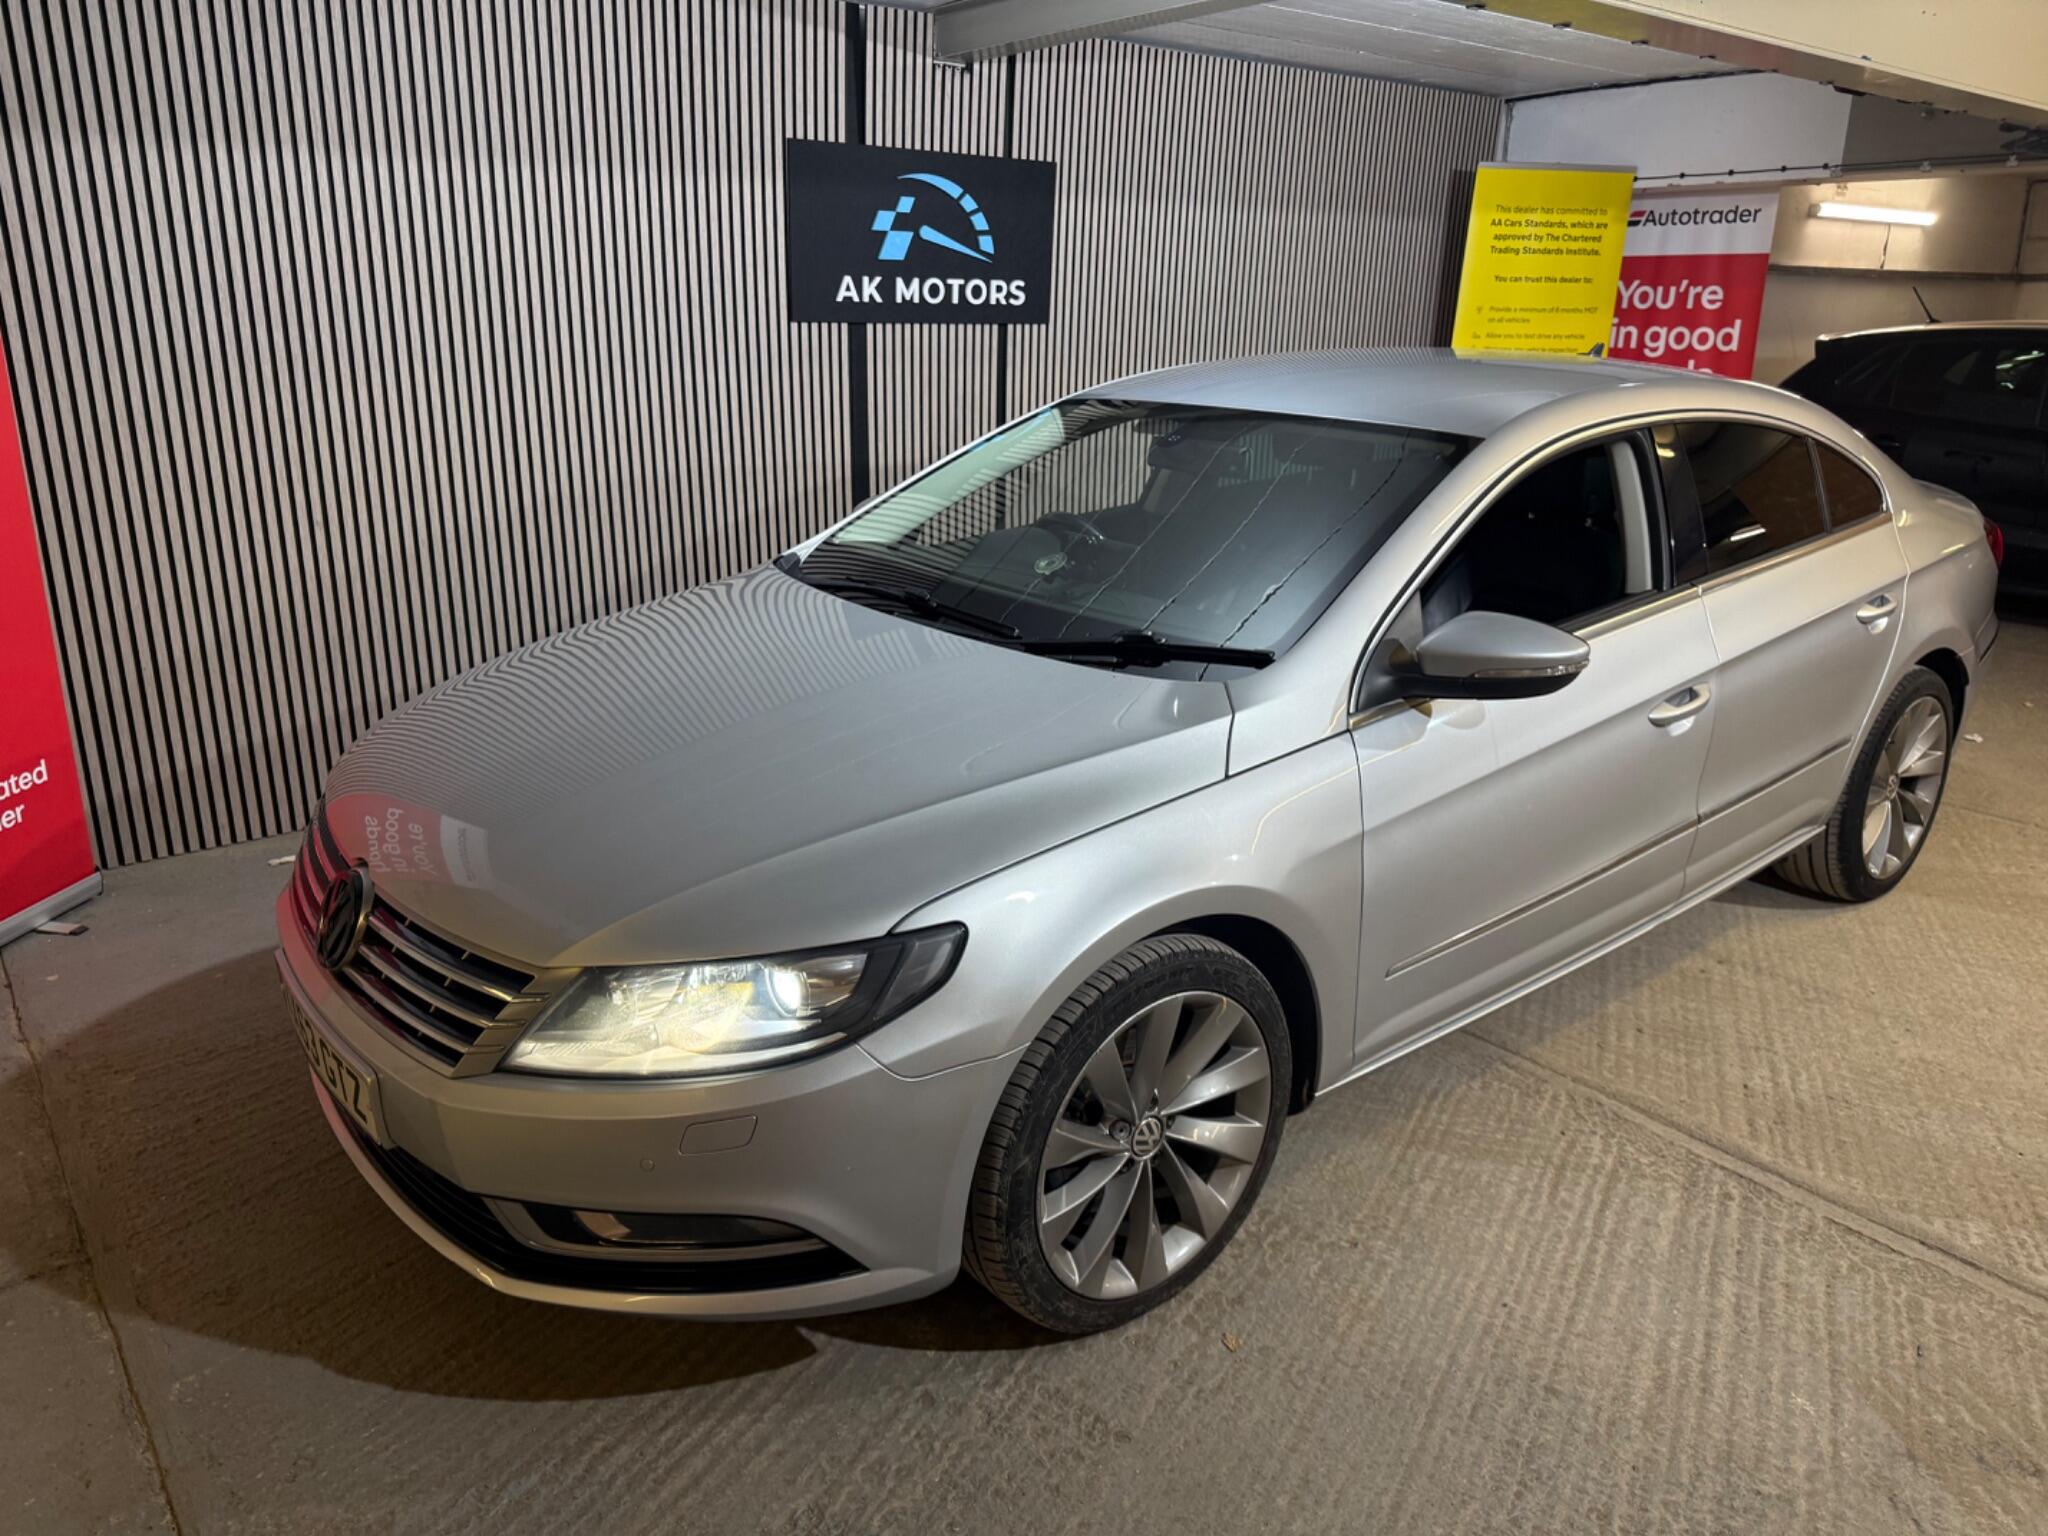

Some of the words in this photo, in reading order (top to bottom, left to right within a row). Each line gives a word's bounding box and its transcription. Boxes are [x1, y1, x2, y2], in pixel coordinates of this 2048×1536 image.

[1496, 204, 1511, 213] This
[1513, 205, 1539, 213] dealer
[1540, 205, 1554, 213] has
[1556, 206, 1598, 215] committed
[1599, 207, 1608, 215] to
[1643, 205, 1762, 227] Autotrader
[1490, 219, 1502, 227] AA
[1503, 219, 1522, 228] Cars
[1523, 219, 1569, 230] Standards,
[1570, 220, 1594, 230] which
[1595, 222, 1608, 230] are
[1493, 233, 1532, 243] approved
[1533, 233, 1544, 243] by
[1546, 232, 1560, 242] The
[1561, 233, 1602, 243] Chartered
[1490, 245, 1520, 256] Trading
[1521, 246, 1564, 256] Standards
[1565, 248, 1602, 257] Institute.
[1494, 275, 1508, 283] You
[1524, 276, 1543, 284] trust
[1544, 276, 1557, 284] this
[1558, 276, 1581, 284] dealer
[835, 275, 883, 304] AK
[895, 276, 1026, 306] MOTORS
[1617, 279, 1725, 310] You're
[1609, 318, 1639, 349] in
[1643, 319, 1742, 358] good
